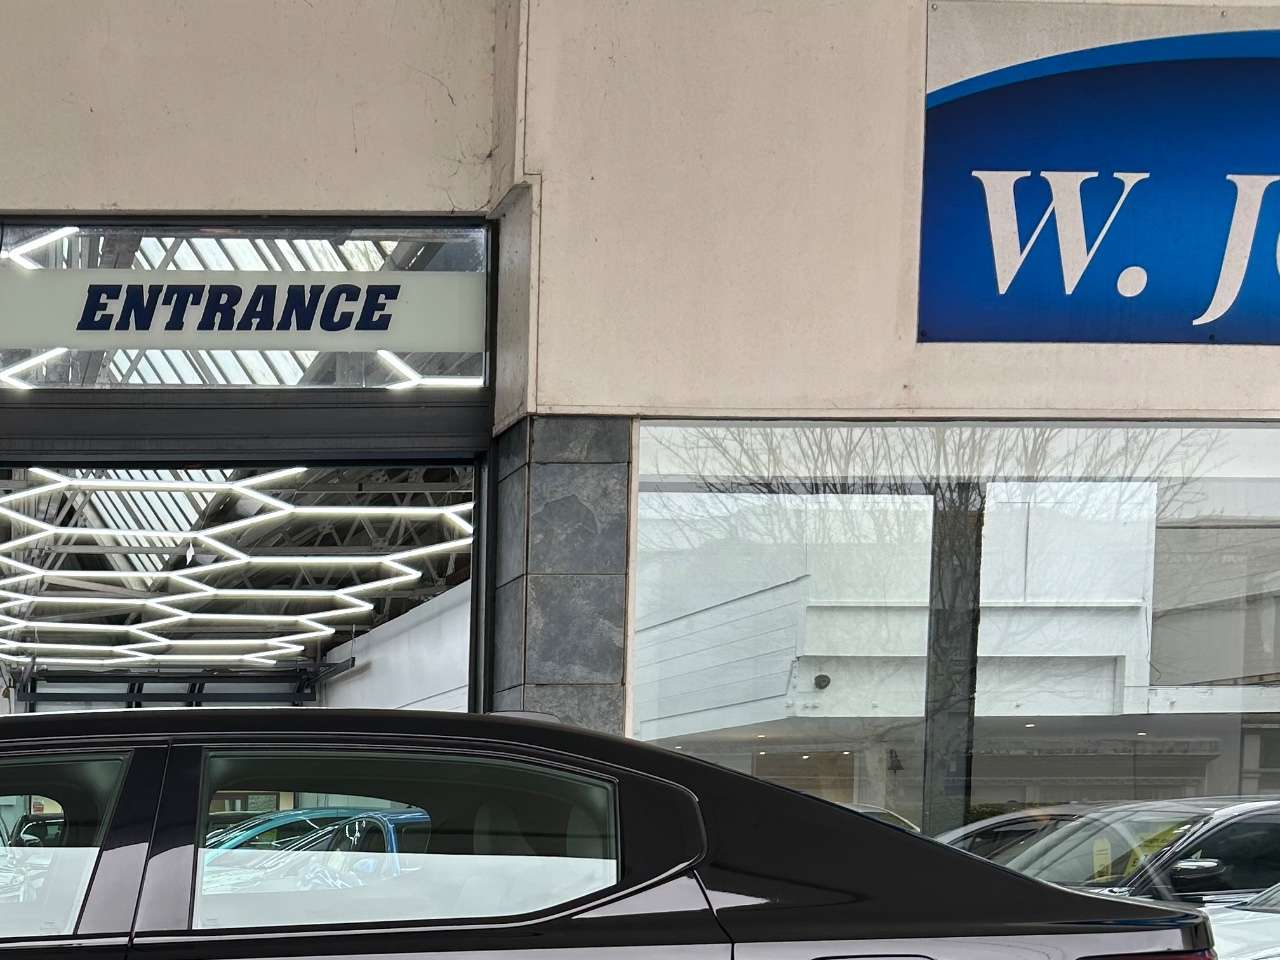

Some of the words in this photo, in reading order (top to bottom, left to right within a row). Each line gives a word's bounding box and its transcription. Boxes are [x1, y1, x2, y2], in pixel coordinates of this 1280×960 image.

[971, 170, 1150, 298] W.
[1192, 174, 1280, 326] J
[75, 283, 402, 332] ENTRANCE
